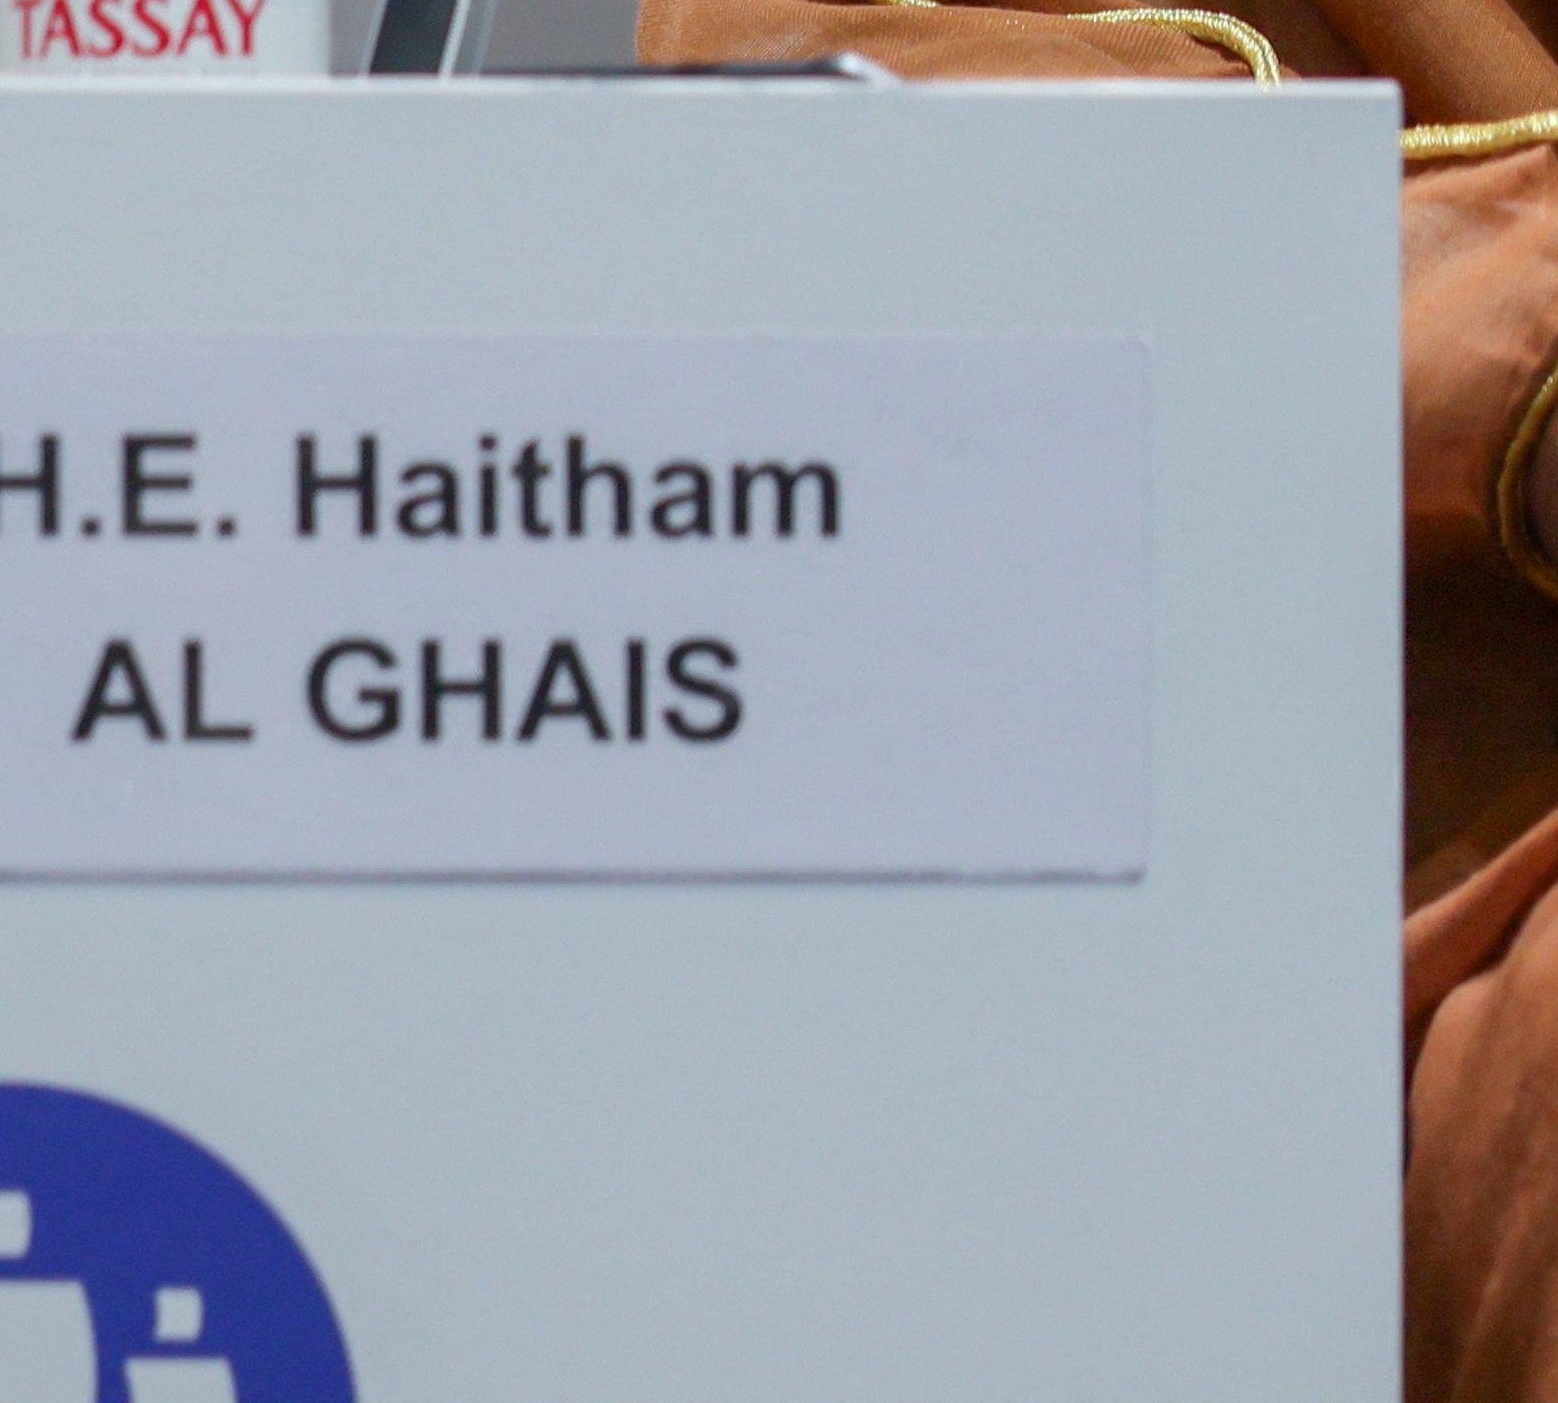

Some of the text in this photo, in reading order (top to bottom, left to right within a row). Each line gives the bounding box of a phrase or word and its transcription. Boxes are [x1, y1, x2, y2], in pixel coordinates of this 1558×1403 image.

[296, 434, 840, 540] Haitham
[71, 637, 743, 744] AL GHAIS
